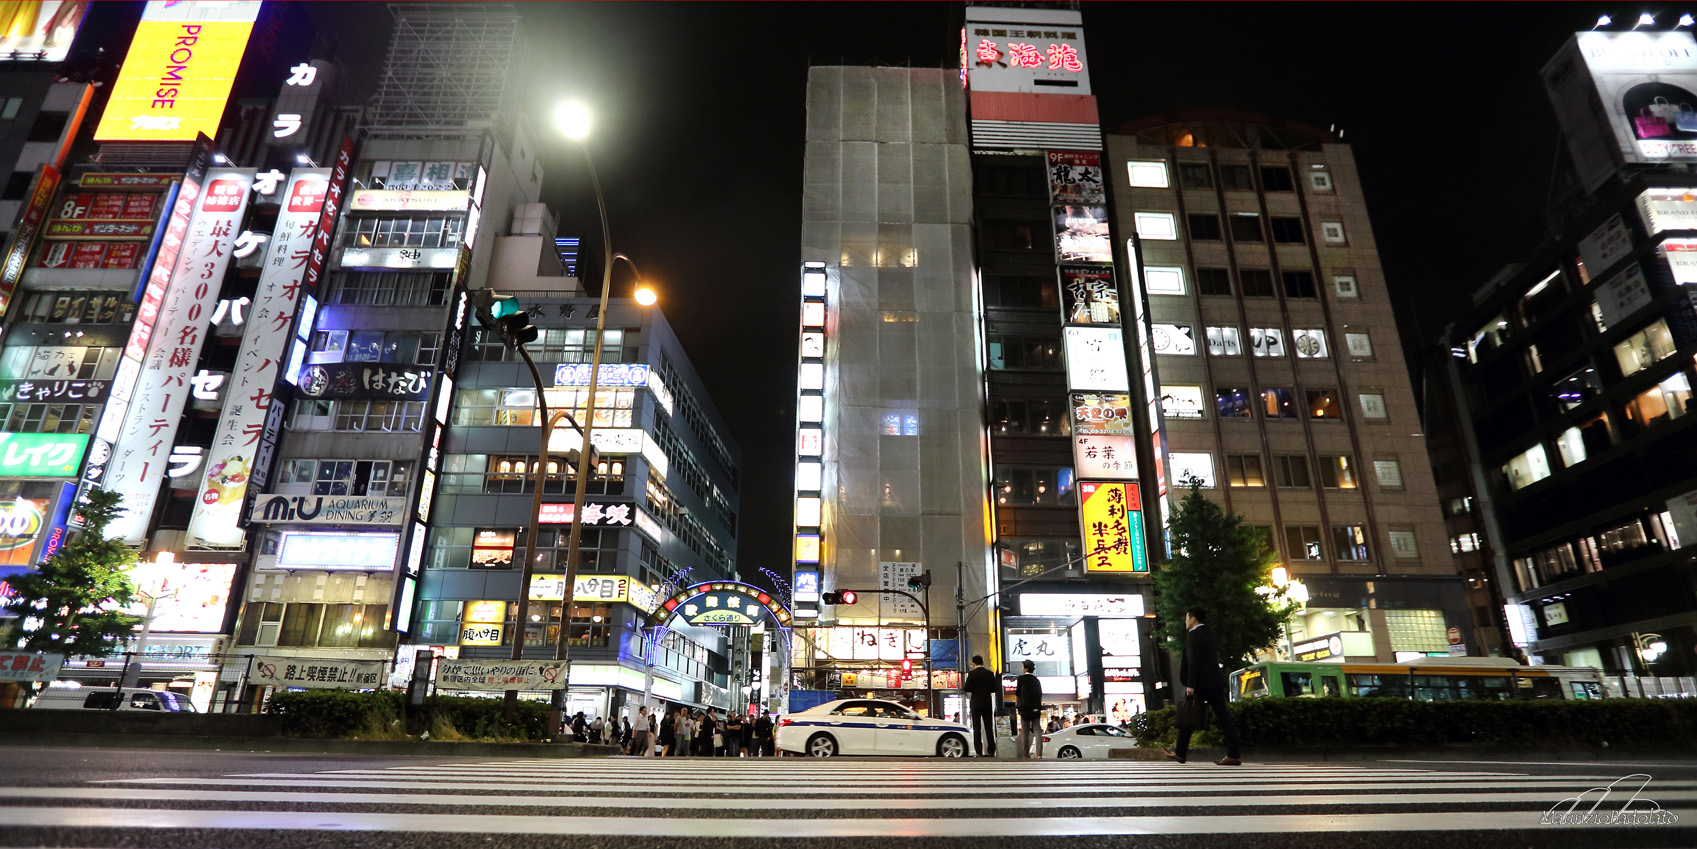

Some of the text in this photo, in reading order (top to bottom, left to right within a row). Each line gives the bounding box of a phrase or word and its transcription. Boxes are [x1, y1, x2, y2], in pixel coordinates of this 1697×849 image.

[976, 39, 1083, 73] 東海苑
[151, 24, 202, 109] PROMISE
[1050, 152, 1064, 163] 9F
[1052, 163, 1100, 186] 龍太
[60, 200, 86, 219] 8F
[271, 219, 320, 333] カラオケ
[1068, 279, 1111, 300] 吉宗
[139, 219, 233, 484] 最大300名様パーティー
[1208, 337, 1237, 348] Darts
[16, 381, 86, 401] きゃりこ
[362, 367, 432, 395] はなび
[222, 404, 244, 446] 誕生会
[3, 442, 76, 467] レイク
[1084, 446, 1116, 460] 若葉
[325, 510, 364, 520] DINING
[327, 499, 389, 511] AQUARIUM
[617, 579, 627, 599] 2F
[883, 565, 891, 602] 全店営中
[703, 614, 742, 622] さくら通り
[462, 628, 500, 641] 腹八分目
[856, 629, 925, 651] ねぎし
[1011, 638, 1055, 657] 虎丸
